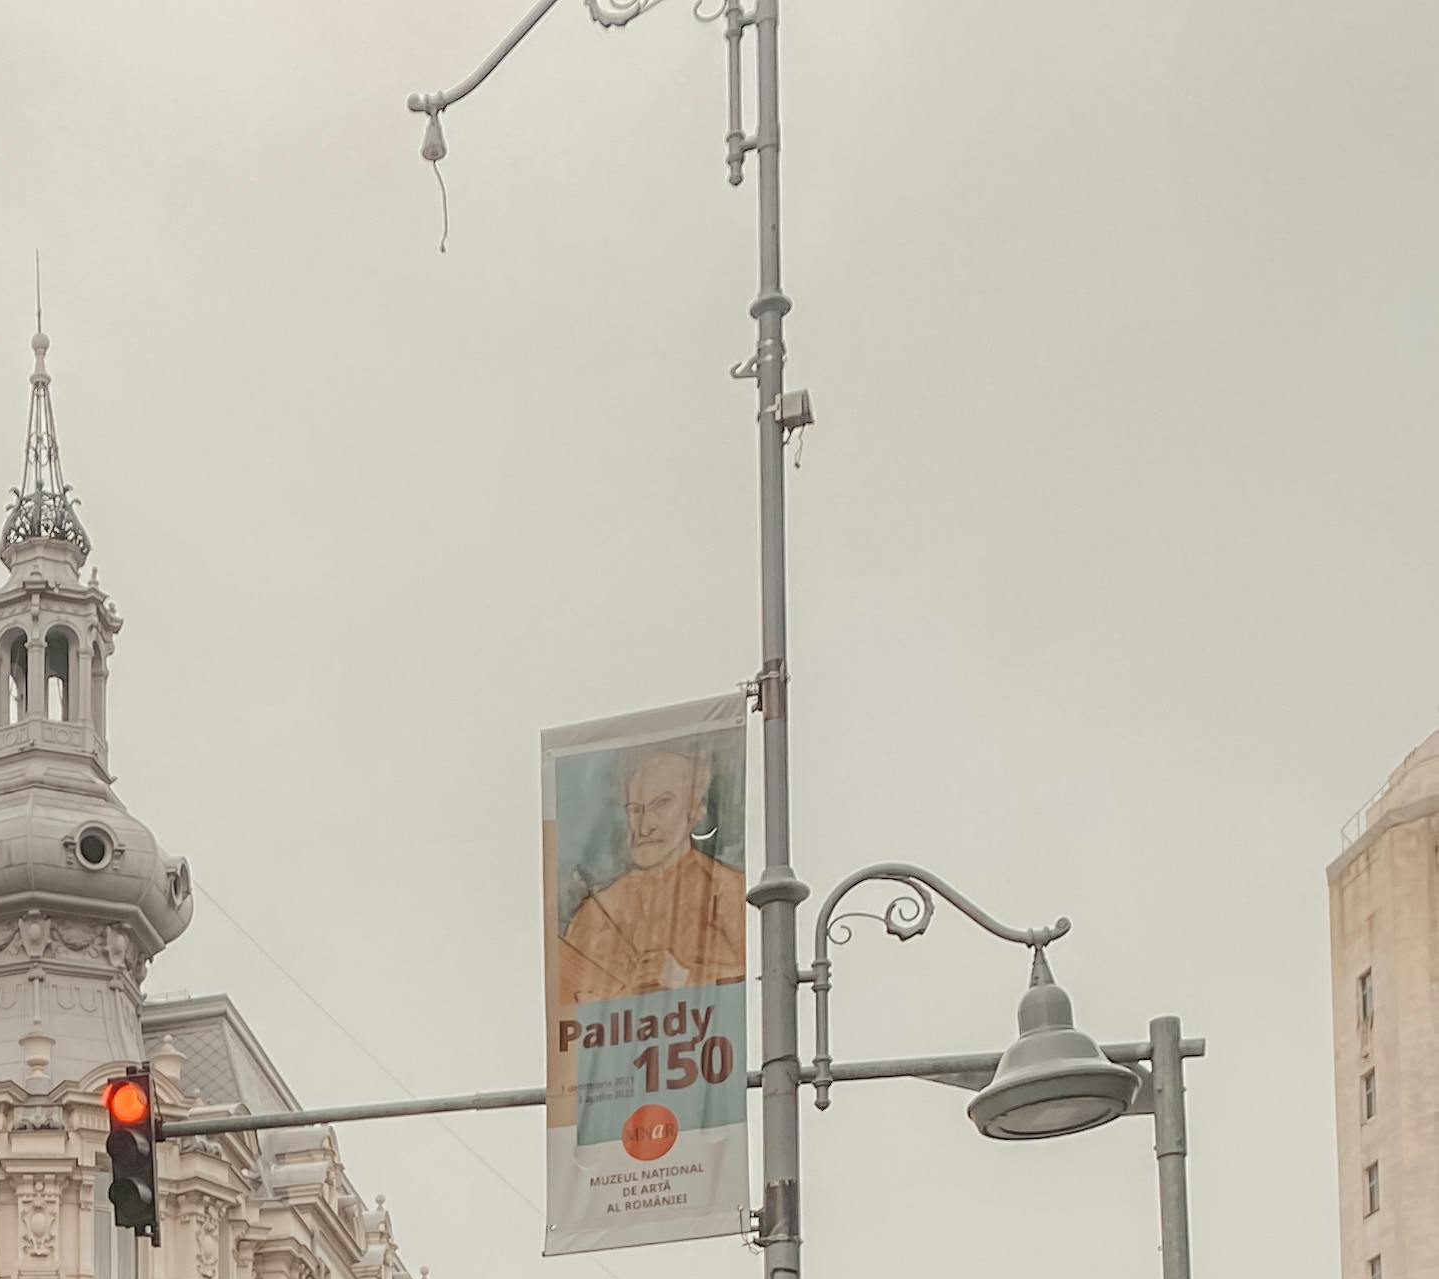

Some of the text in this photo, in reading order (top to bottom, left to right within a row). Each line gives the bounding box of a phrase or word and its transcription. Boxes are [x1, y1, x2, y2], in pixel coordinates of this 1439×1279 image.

[559, 1001, 714, 1052] Pallady
[633, 1036, 733, 1093] 150
[589, 1172, 639, 1187] MUZEUL
[622, 1180, 671, 1198] DE ARTĂ
[607, 1203, 622, 1214] AL
